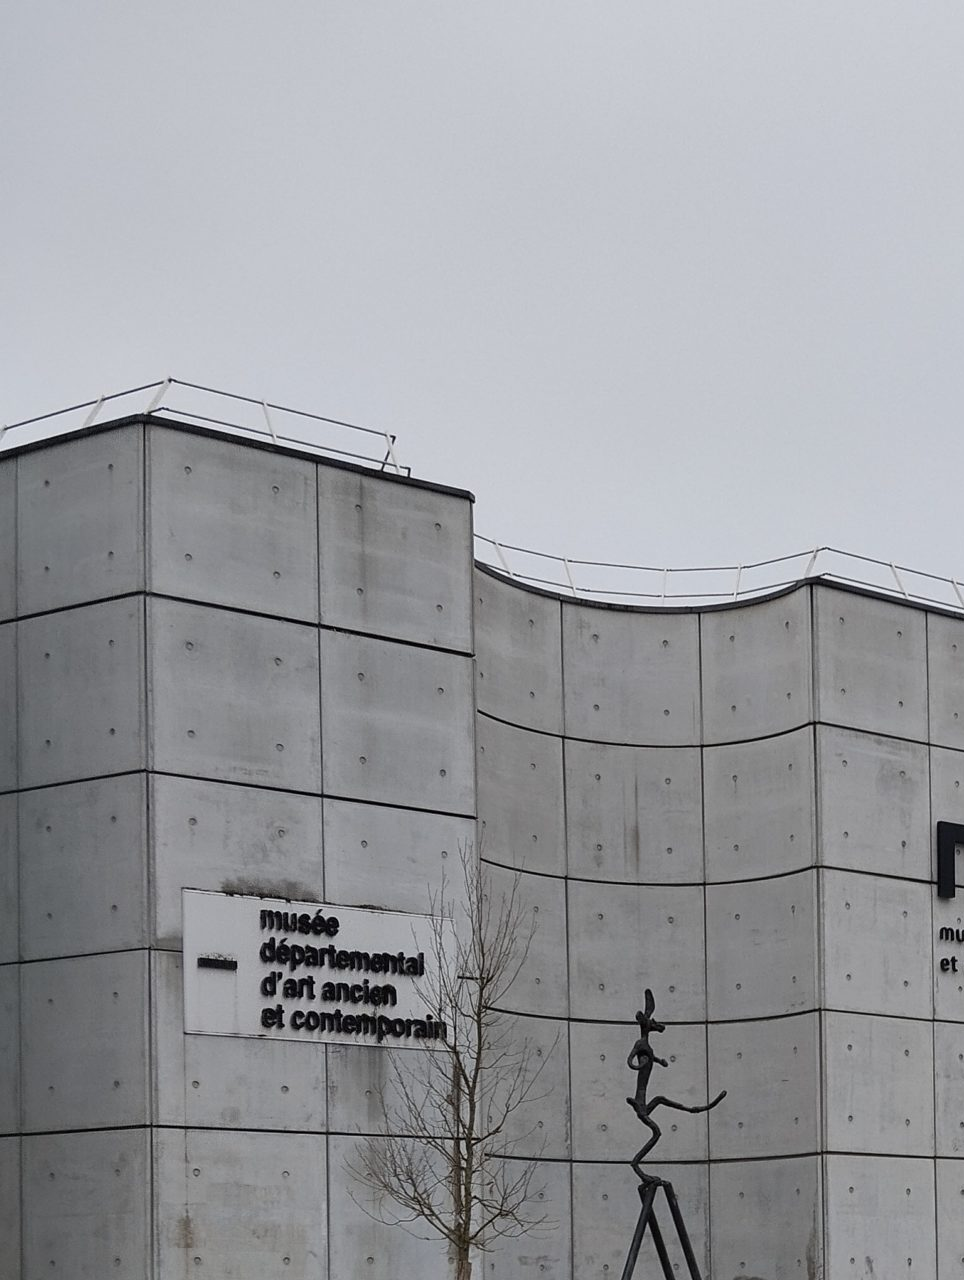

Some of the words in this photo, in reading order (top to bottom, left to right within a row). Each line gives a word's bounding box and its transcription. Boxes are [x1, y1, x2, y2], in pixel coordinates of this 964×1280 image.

[260, 909, 340, 936] musée
[260, 937, 425, 976] départemental
[940, 956, 958, 973] et
[260, 971, 316, 1000] d'art
[321, 979, 397, 1006] ancien
[261, 1004, 285, 1029] et
[290, 1009, 448, 1043] contemporain
